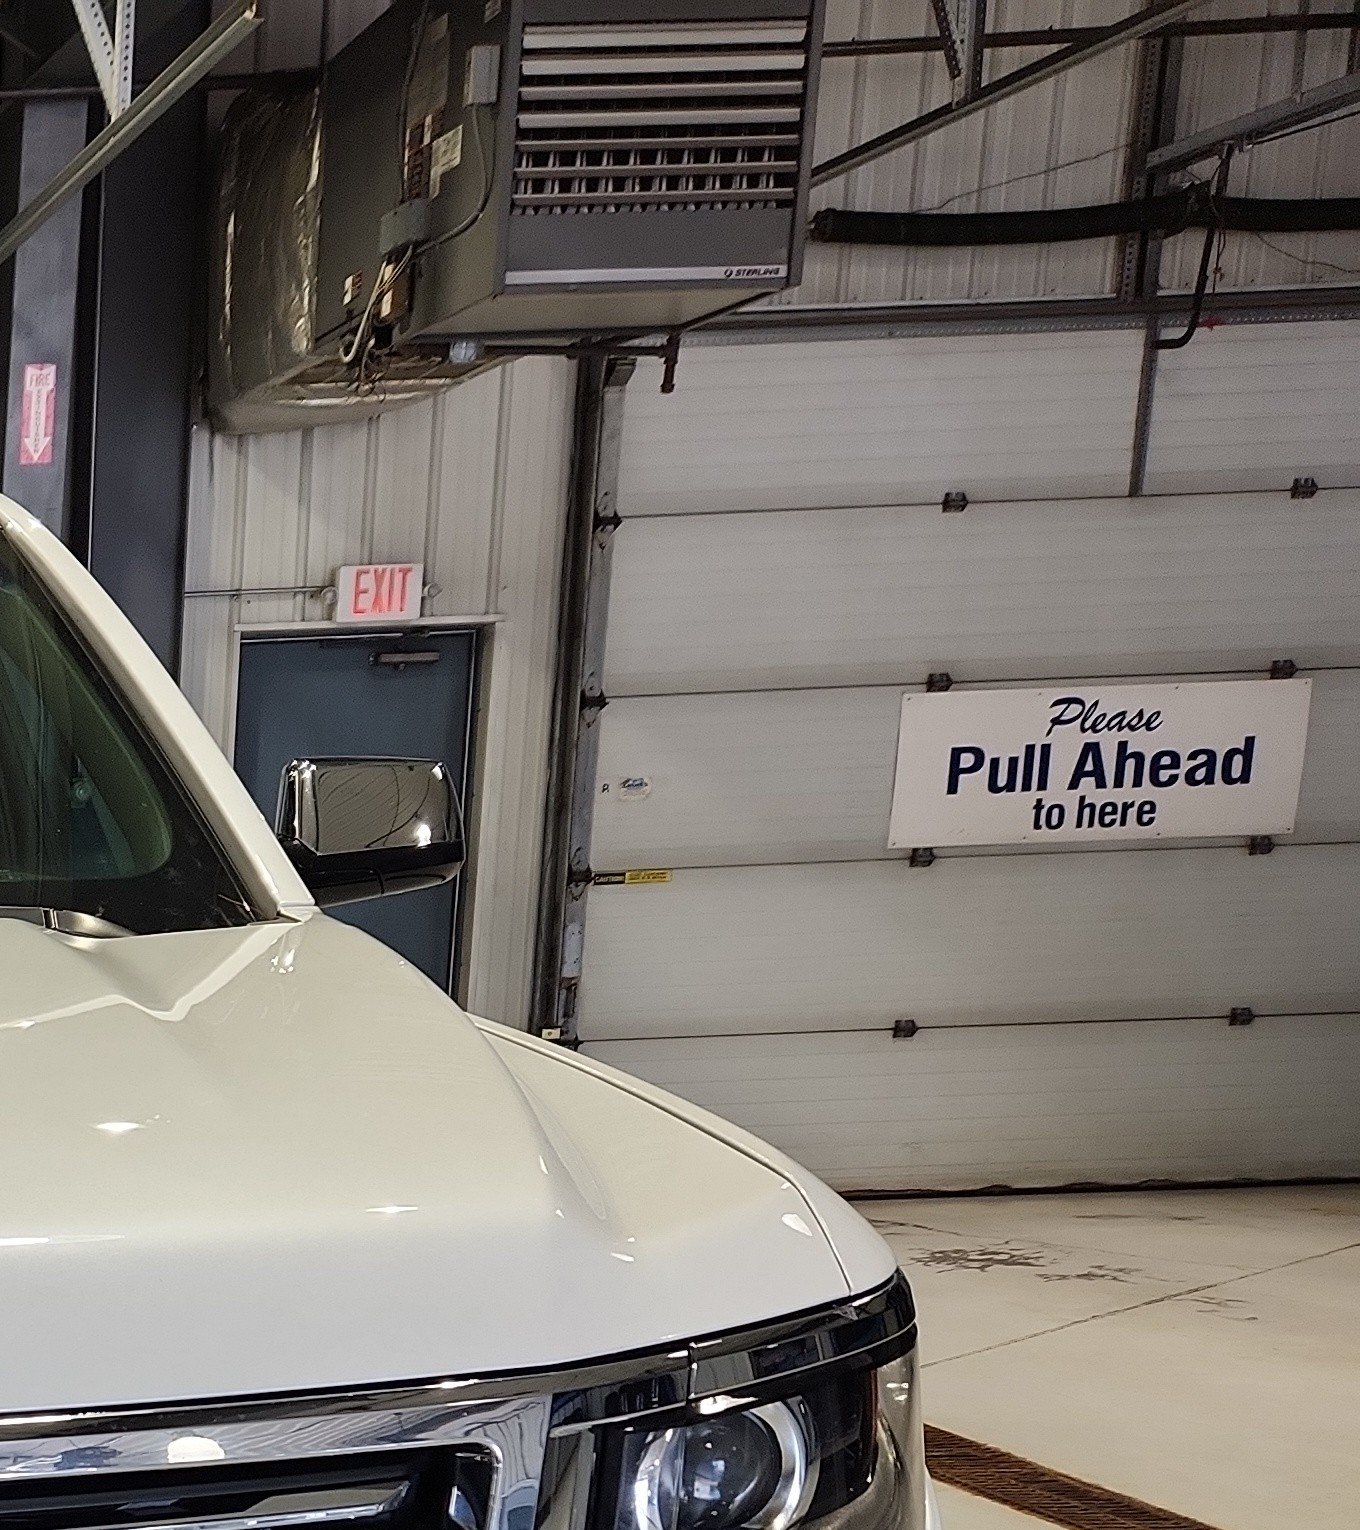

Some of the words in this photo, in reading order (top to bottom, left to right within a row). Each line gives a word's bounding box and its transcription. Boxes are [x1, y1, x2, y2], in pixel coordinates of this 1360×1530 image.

[30, 373, 51, 387] FIRE
[353, 567, 412, 613] EXIT
[1045, 697, 1164, 737] Please
[946, 743, 1052, 796] Pull
[1067, 735, 1256, 791] Ahead
[1032, 797, 1066, 831] to
[1075, 795, 1157, 830] here
